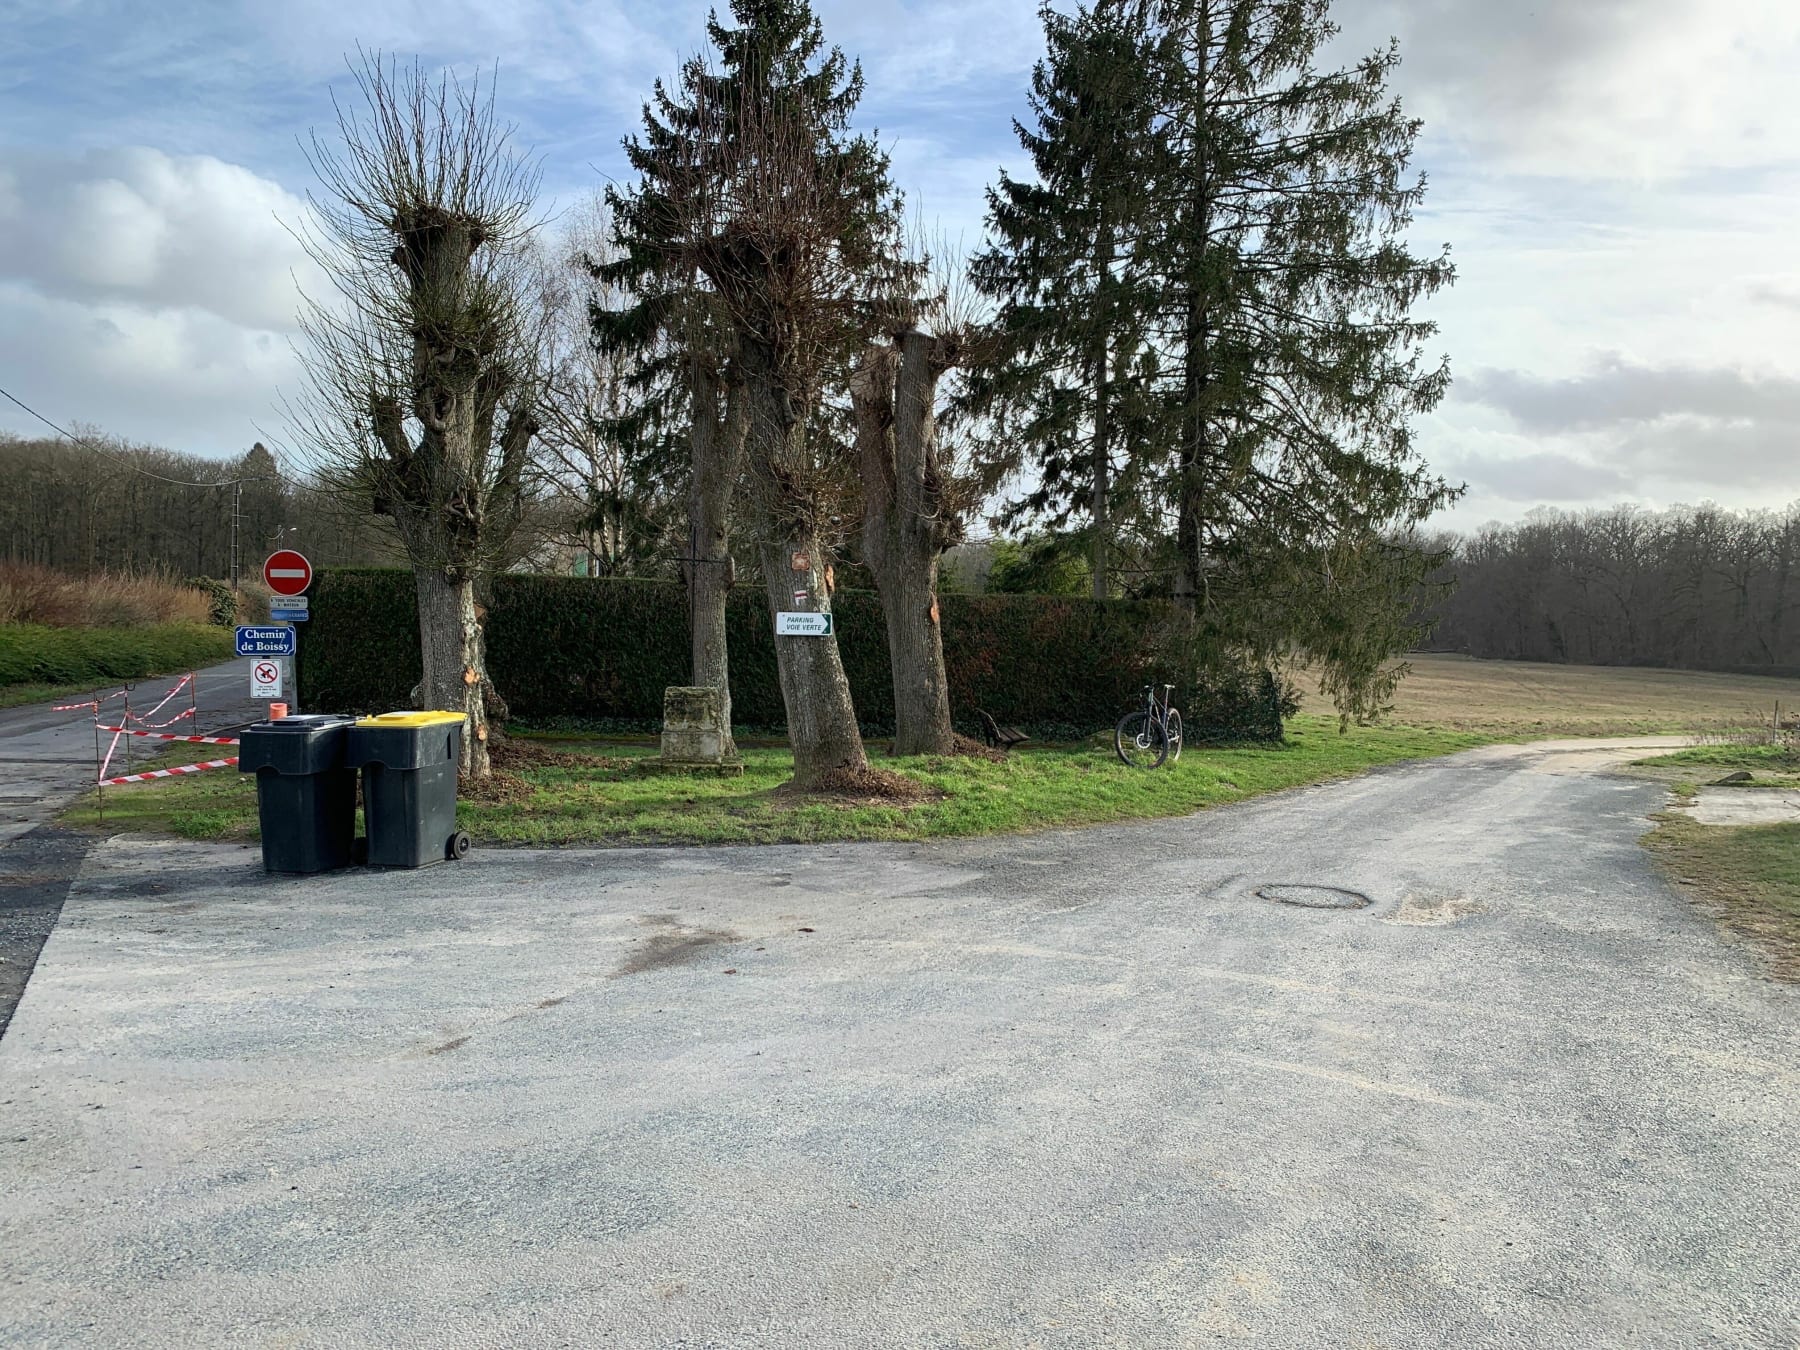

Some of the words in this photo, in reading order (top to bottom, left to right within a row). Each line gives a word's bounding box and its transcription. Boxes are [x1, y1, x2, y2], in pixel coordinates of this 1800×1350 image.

[245, 629, 286, 639] Chemin
[241, 641, 254, 651] de
[255, 641, 289, 653] Boissy
